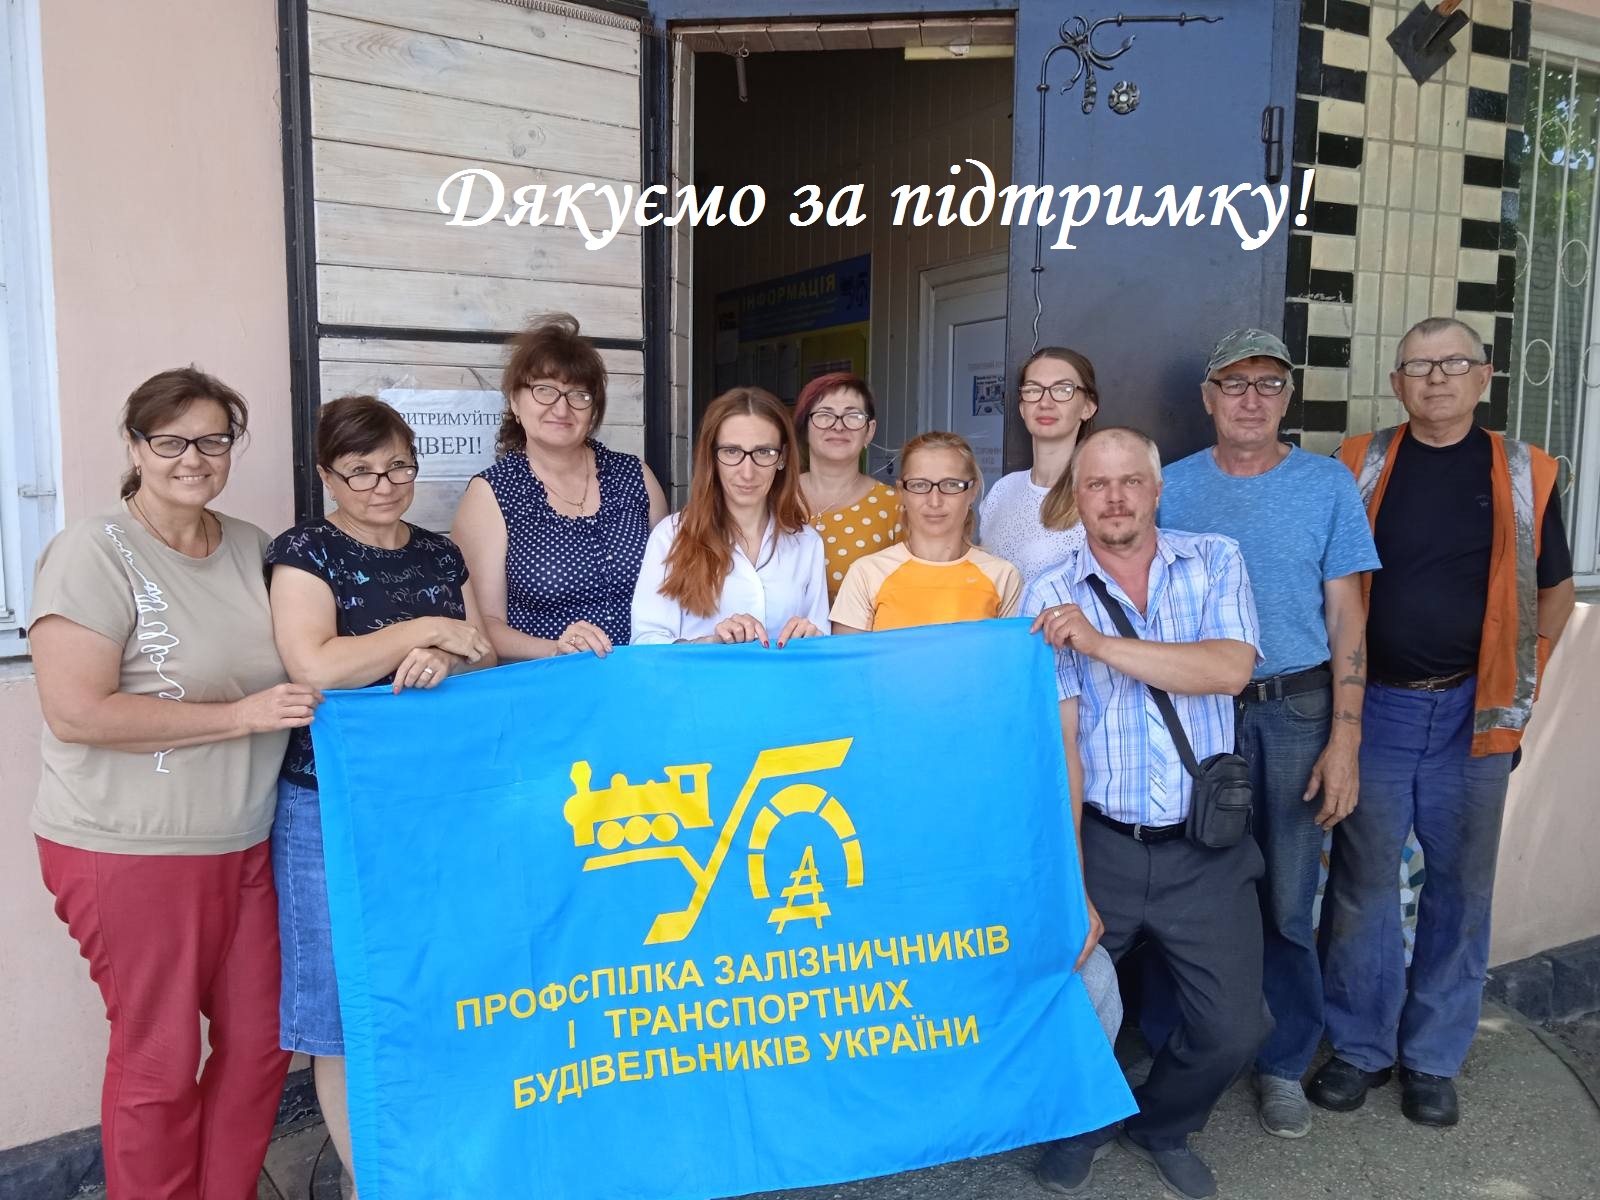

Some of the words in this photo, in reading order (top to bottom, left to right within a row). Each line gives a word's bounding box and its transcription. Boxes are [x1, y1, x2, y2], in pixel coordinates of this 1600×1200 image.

[743, 272, 835, 312] ІНФОРМАЦІЯ
[456, 959, 705, 1030] ПРОФСПІЛКА
[715, 925, 1010, 985] ЗАЛІЗНИЧНИКІВ
[568, 1020, 576, 1048] І
[605, 979, 913, 1038] ТРАНСПОРТНИХ
[513, 1035, 811, 1109] БУДІВЕЛЬНИКІВ
[820, 1014, 980, 1061] УКРАЇНИ
